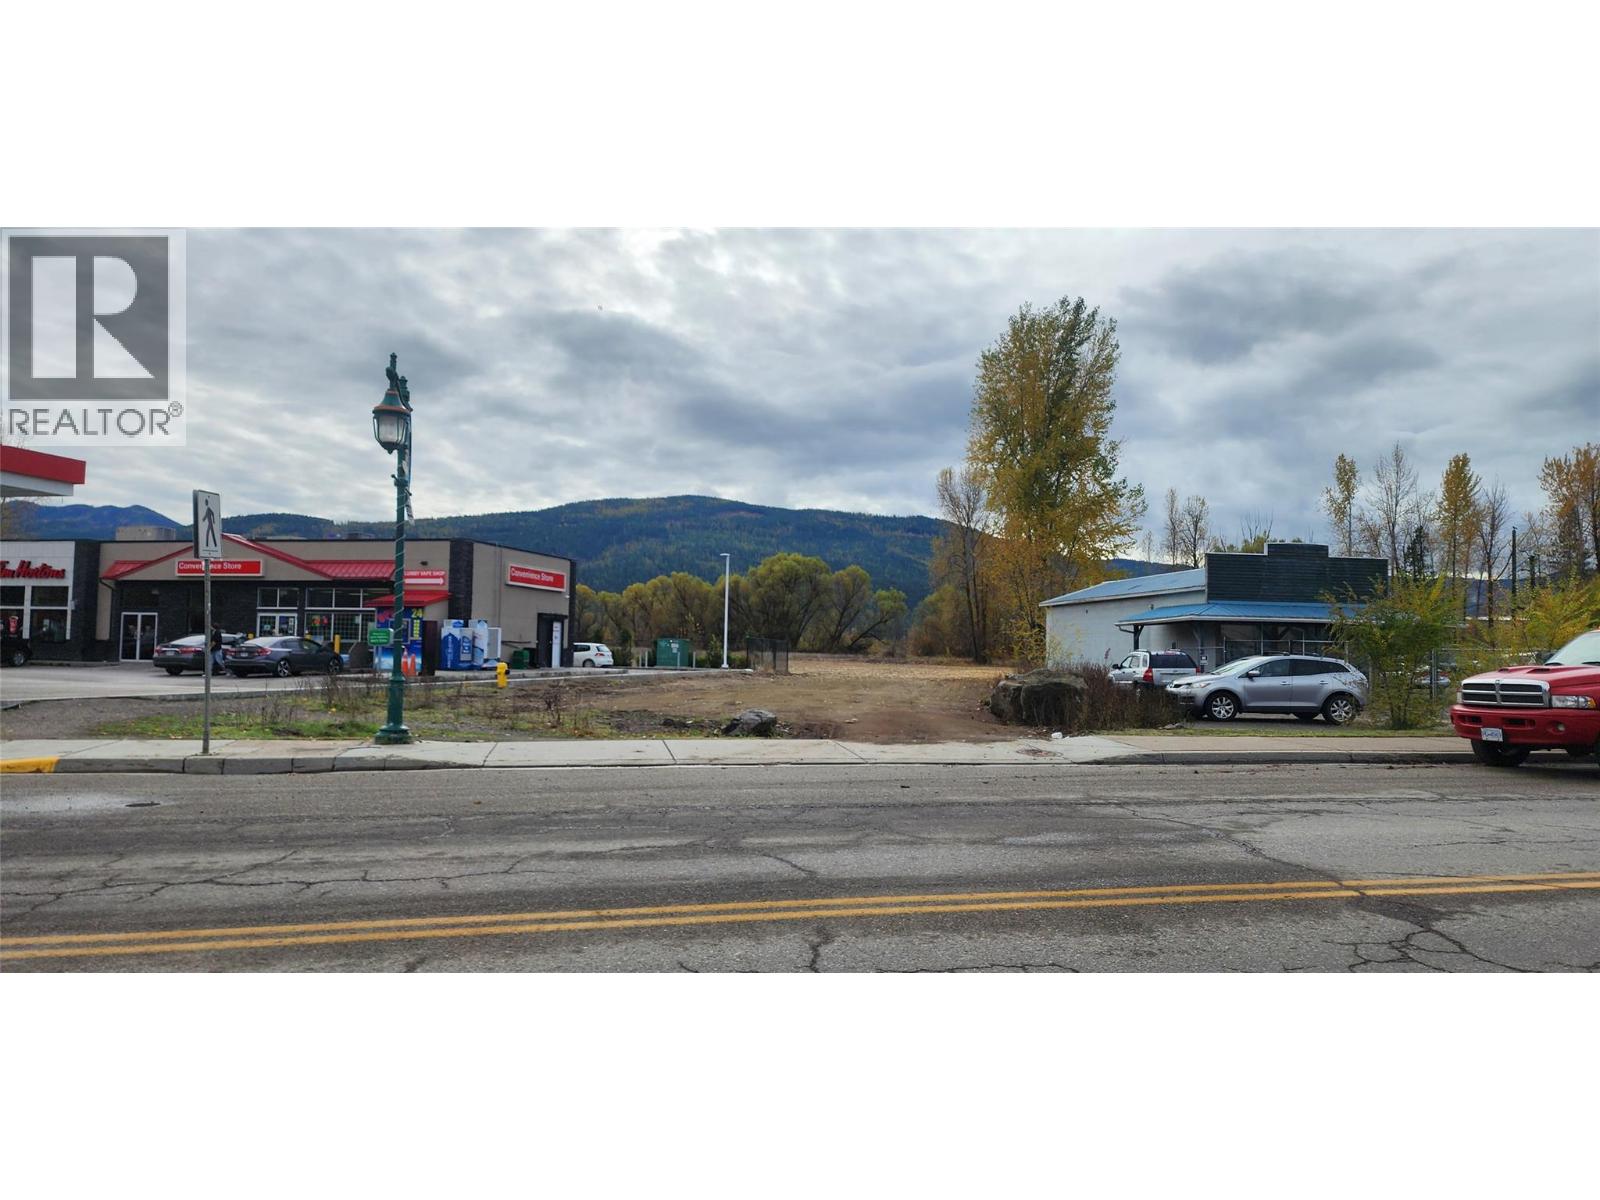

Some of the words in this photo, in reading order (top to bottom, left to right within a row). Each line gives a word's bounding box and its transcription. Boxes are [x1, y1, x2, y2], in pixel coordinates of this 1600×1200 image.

[15, 559, 66, 579] Hortons
[178, 561, 222, 570] Convennce
[223, 561, 242, 570] Store
[511, 567, 540, 580] Convenience
[540, 572, 554, 582] Store
[411, 607, 423, 618] 24
